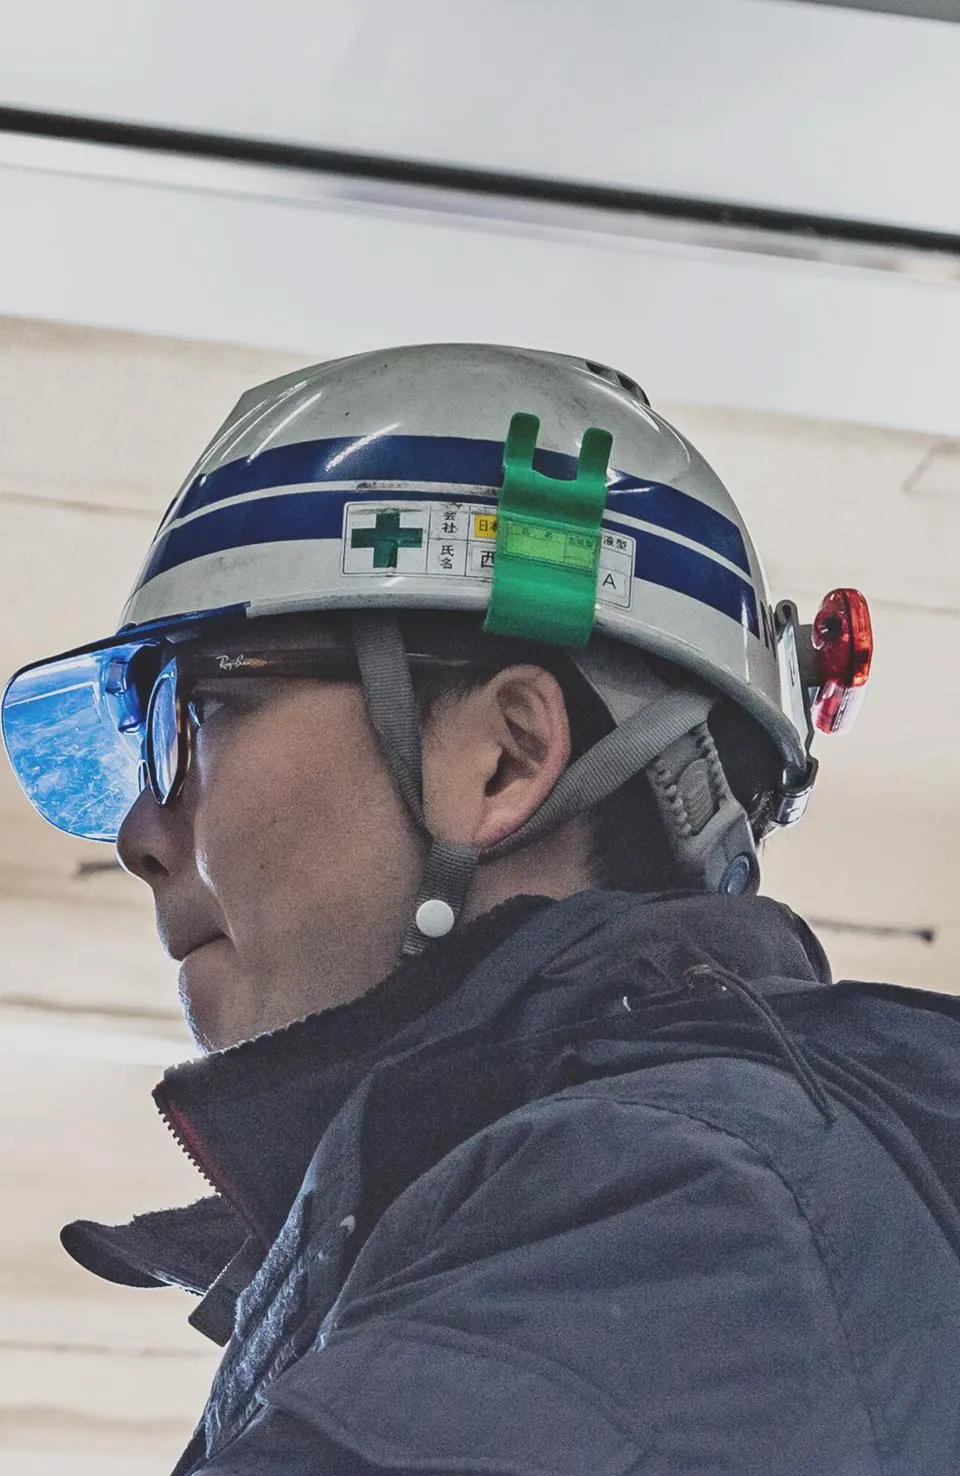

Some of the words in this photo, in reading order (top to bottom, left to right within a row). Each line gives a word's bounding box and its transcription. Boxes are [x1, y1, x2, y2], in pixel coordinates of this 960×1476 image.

[442, 511, 456, 533] 会社
[440, 545, 454, 569] 氏名
[602, 573, 616, 590] A
